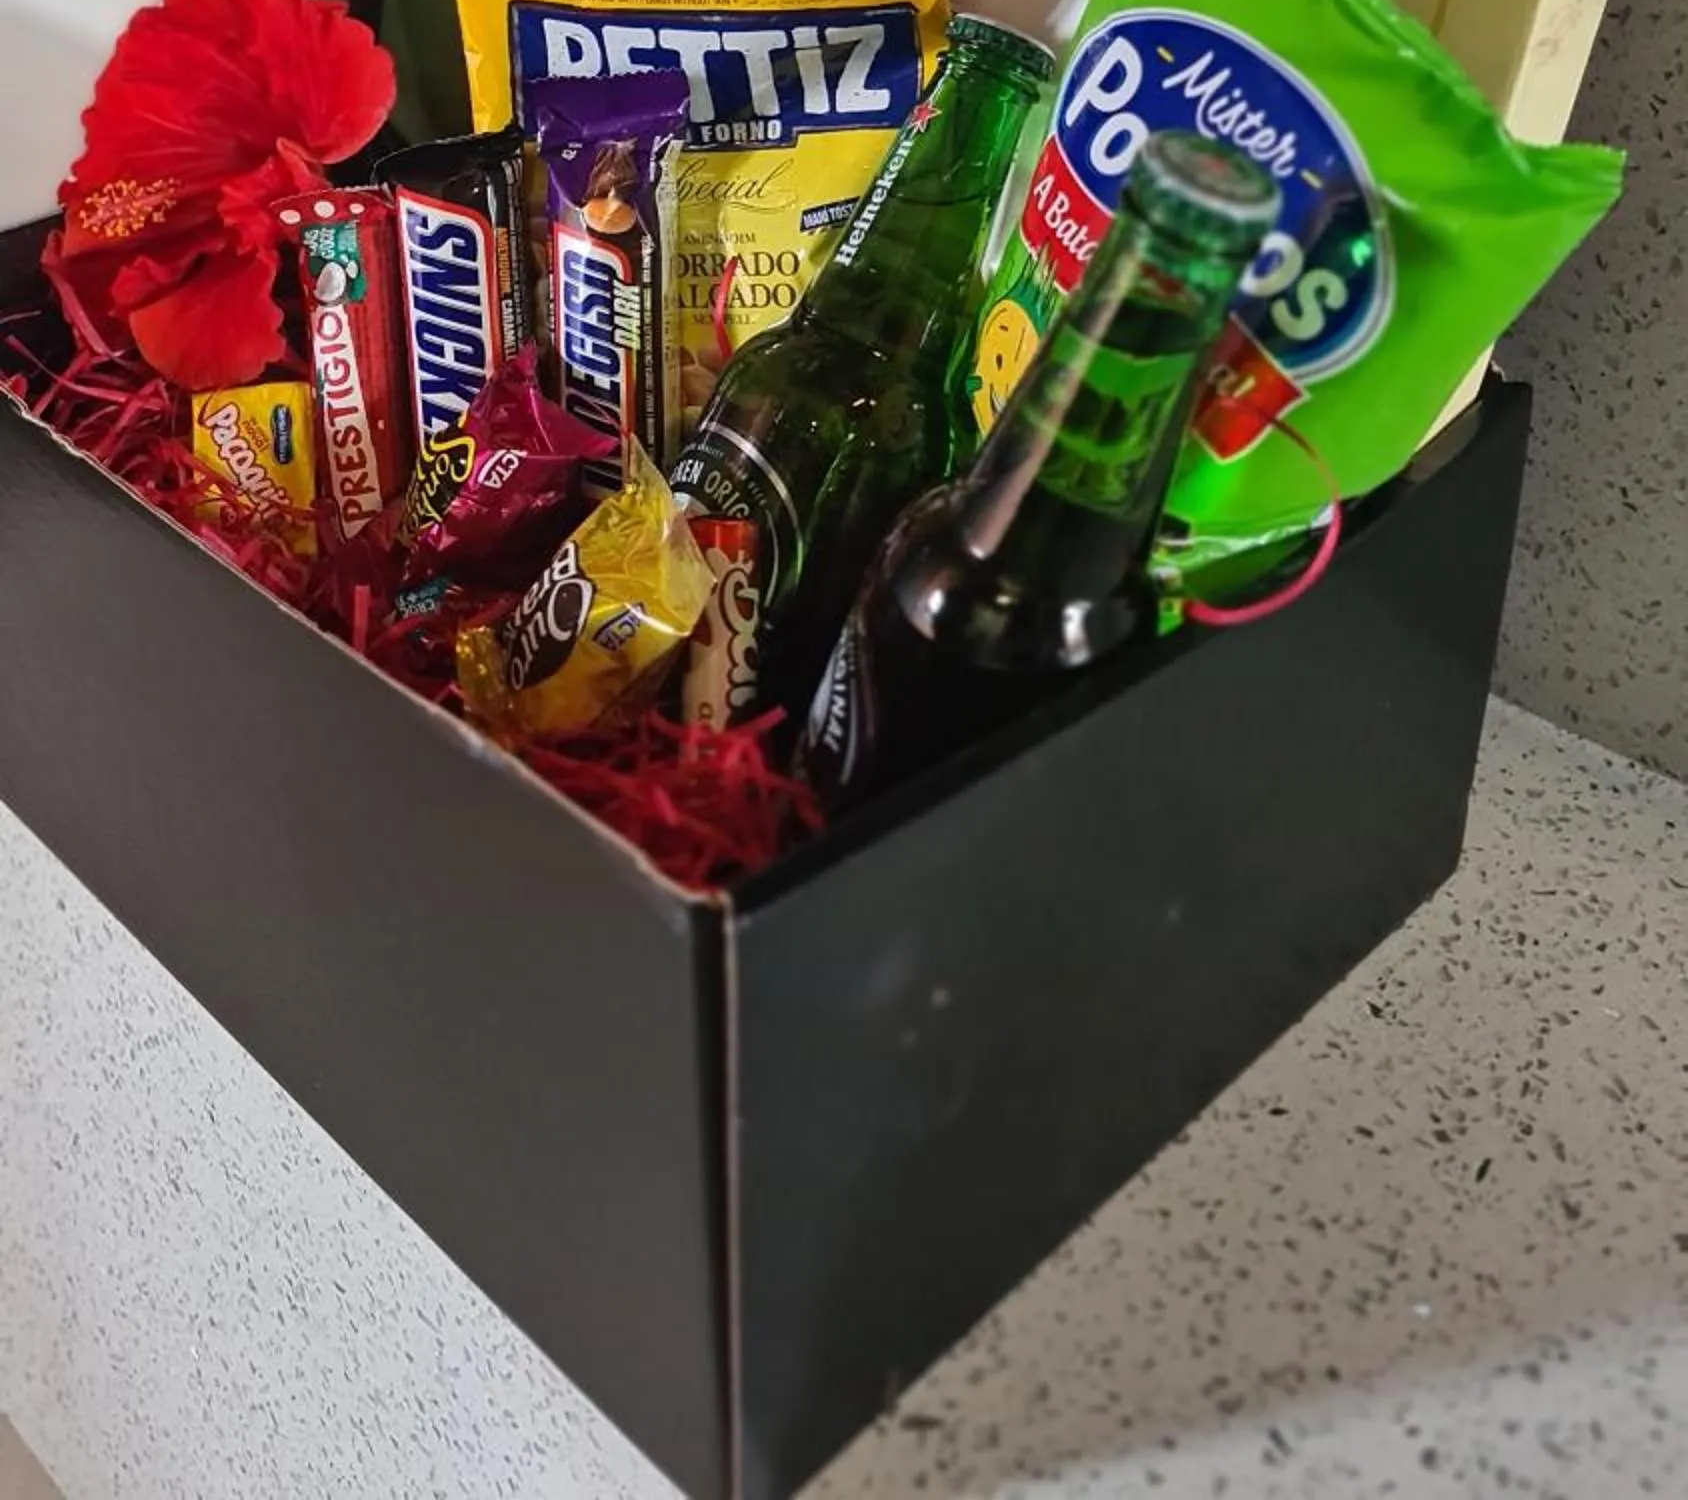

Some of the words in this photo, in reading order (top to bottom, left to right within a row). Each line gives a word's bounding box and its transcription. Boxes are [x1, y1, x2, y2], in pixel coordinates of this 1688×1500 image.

[701, 118, 782, 143] FORNO
[1162, 50, 1296, 178] Mister
[676, 156, 795, 204] pecial
[833, 134, 916, 267] Heineken
[1033, 175, 1060, 219] A
[1046, 193, 1098, 262] Bata
[676, 250, 801, 277] ORRADO
[676, 283, 797, 309] ALGADO
[406, 207, 488, 432] SNICKE
[614, 284, 642, 352] DARK
[563, 248, 625, 491] IDECISO
[703, 468, 751, 518] ORIG
[508, 577, 596, 691] Ouro
